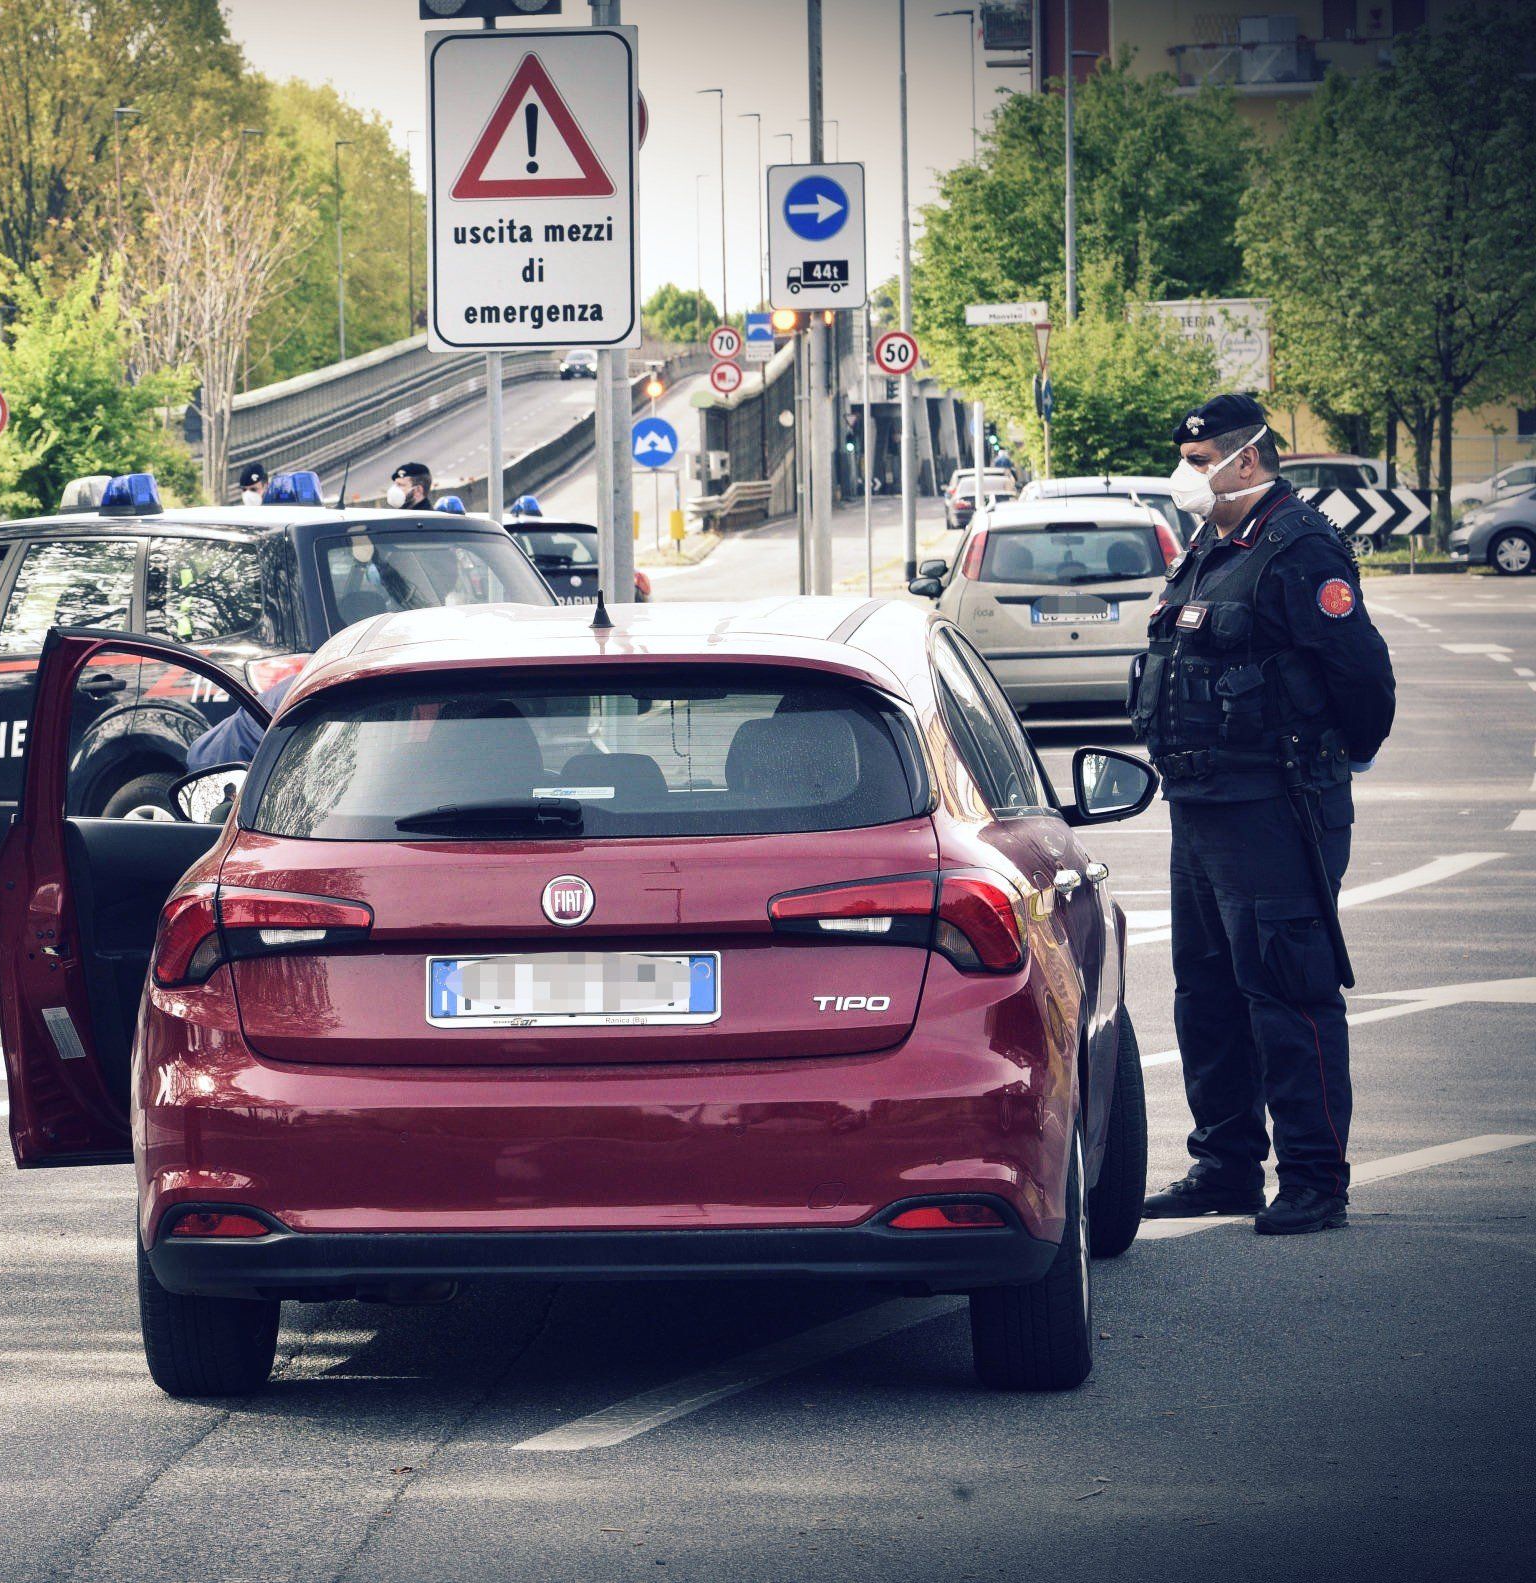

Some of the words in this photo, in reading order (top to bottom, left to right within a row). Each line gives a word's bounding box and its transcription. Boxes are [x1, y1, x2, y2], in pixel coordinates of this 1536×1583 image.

[453, 218, 533, 244] uscita
[544, 215, 613, 242] mezzi
[521, 257, 544, 282] di
[812, 263, 839, 280] 44t
[464, 303, 604, 329] emergenza
[717, 335, 734, 351] 70
[884, 343, 910, 363] 50
[554, 889, 583, 912] FIAT
[813, 996, 891, 1011] TIPO
